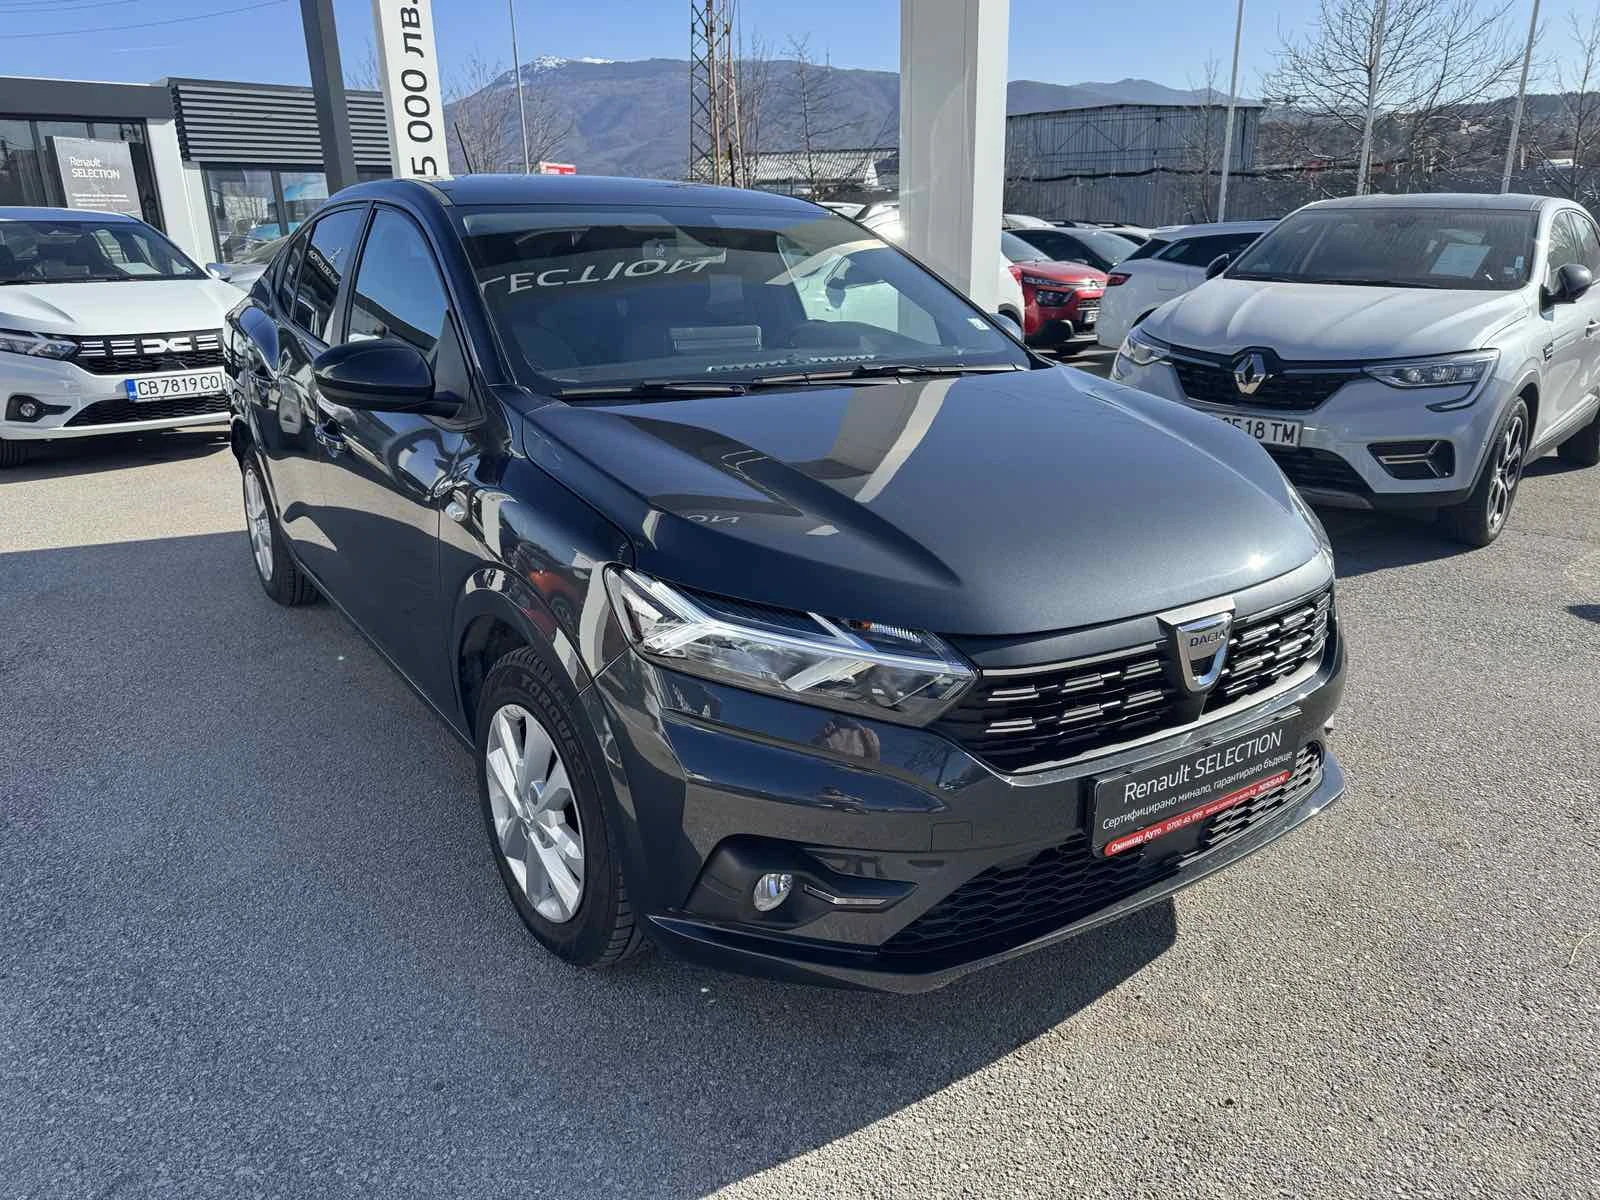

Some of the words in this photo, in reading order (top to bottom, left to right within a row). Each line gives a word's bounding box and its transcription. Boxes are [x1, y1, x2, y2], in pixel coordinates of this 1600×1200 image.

[400, 69, 433, 143] 000
[71, 168, 121, 179] SELECTION
[1271, 422, 1296, 444] TM
[1190, 631, 1226, 647] DACIA
[1123, 764, 1191, 804] Renault
[1194, 729, 1283, 778] SELECTION
[1102, 796, 1177, 830] Сертифицирано
[1213, 763, 1263, 789] гарантирано
[1144, 827, 1162, 841] Ауто
